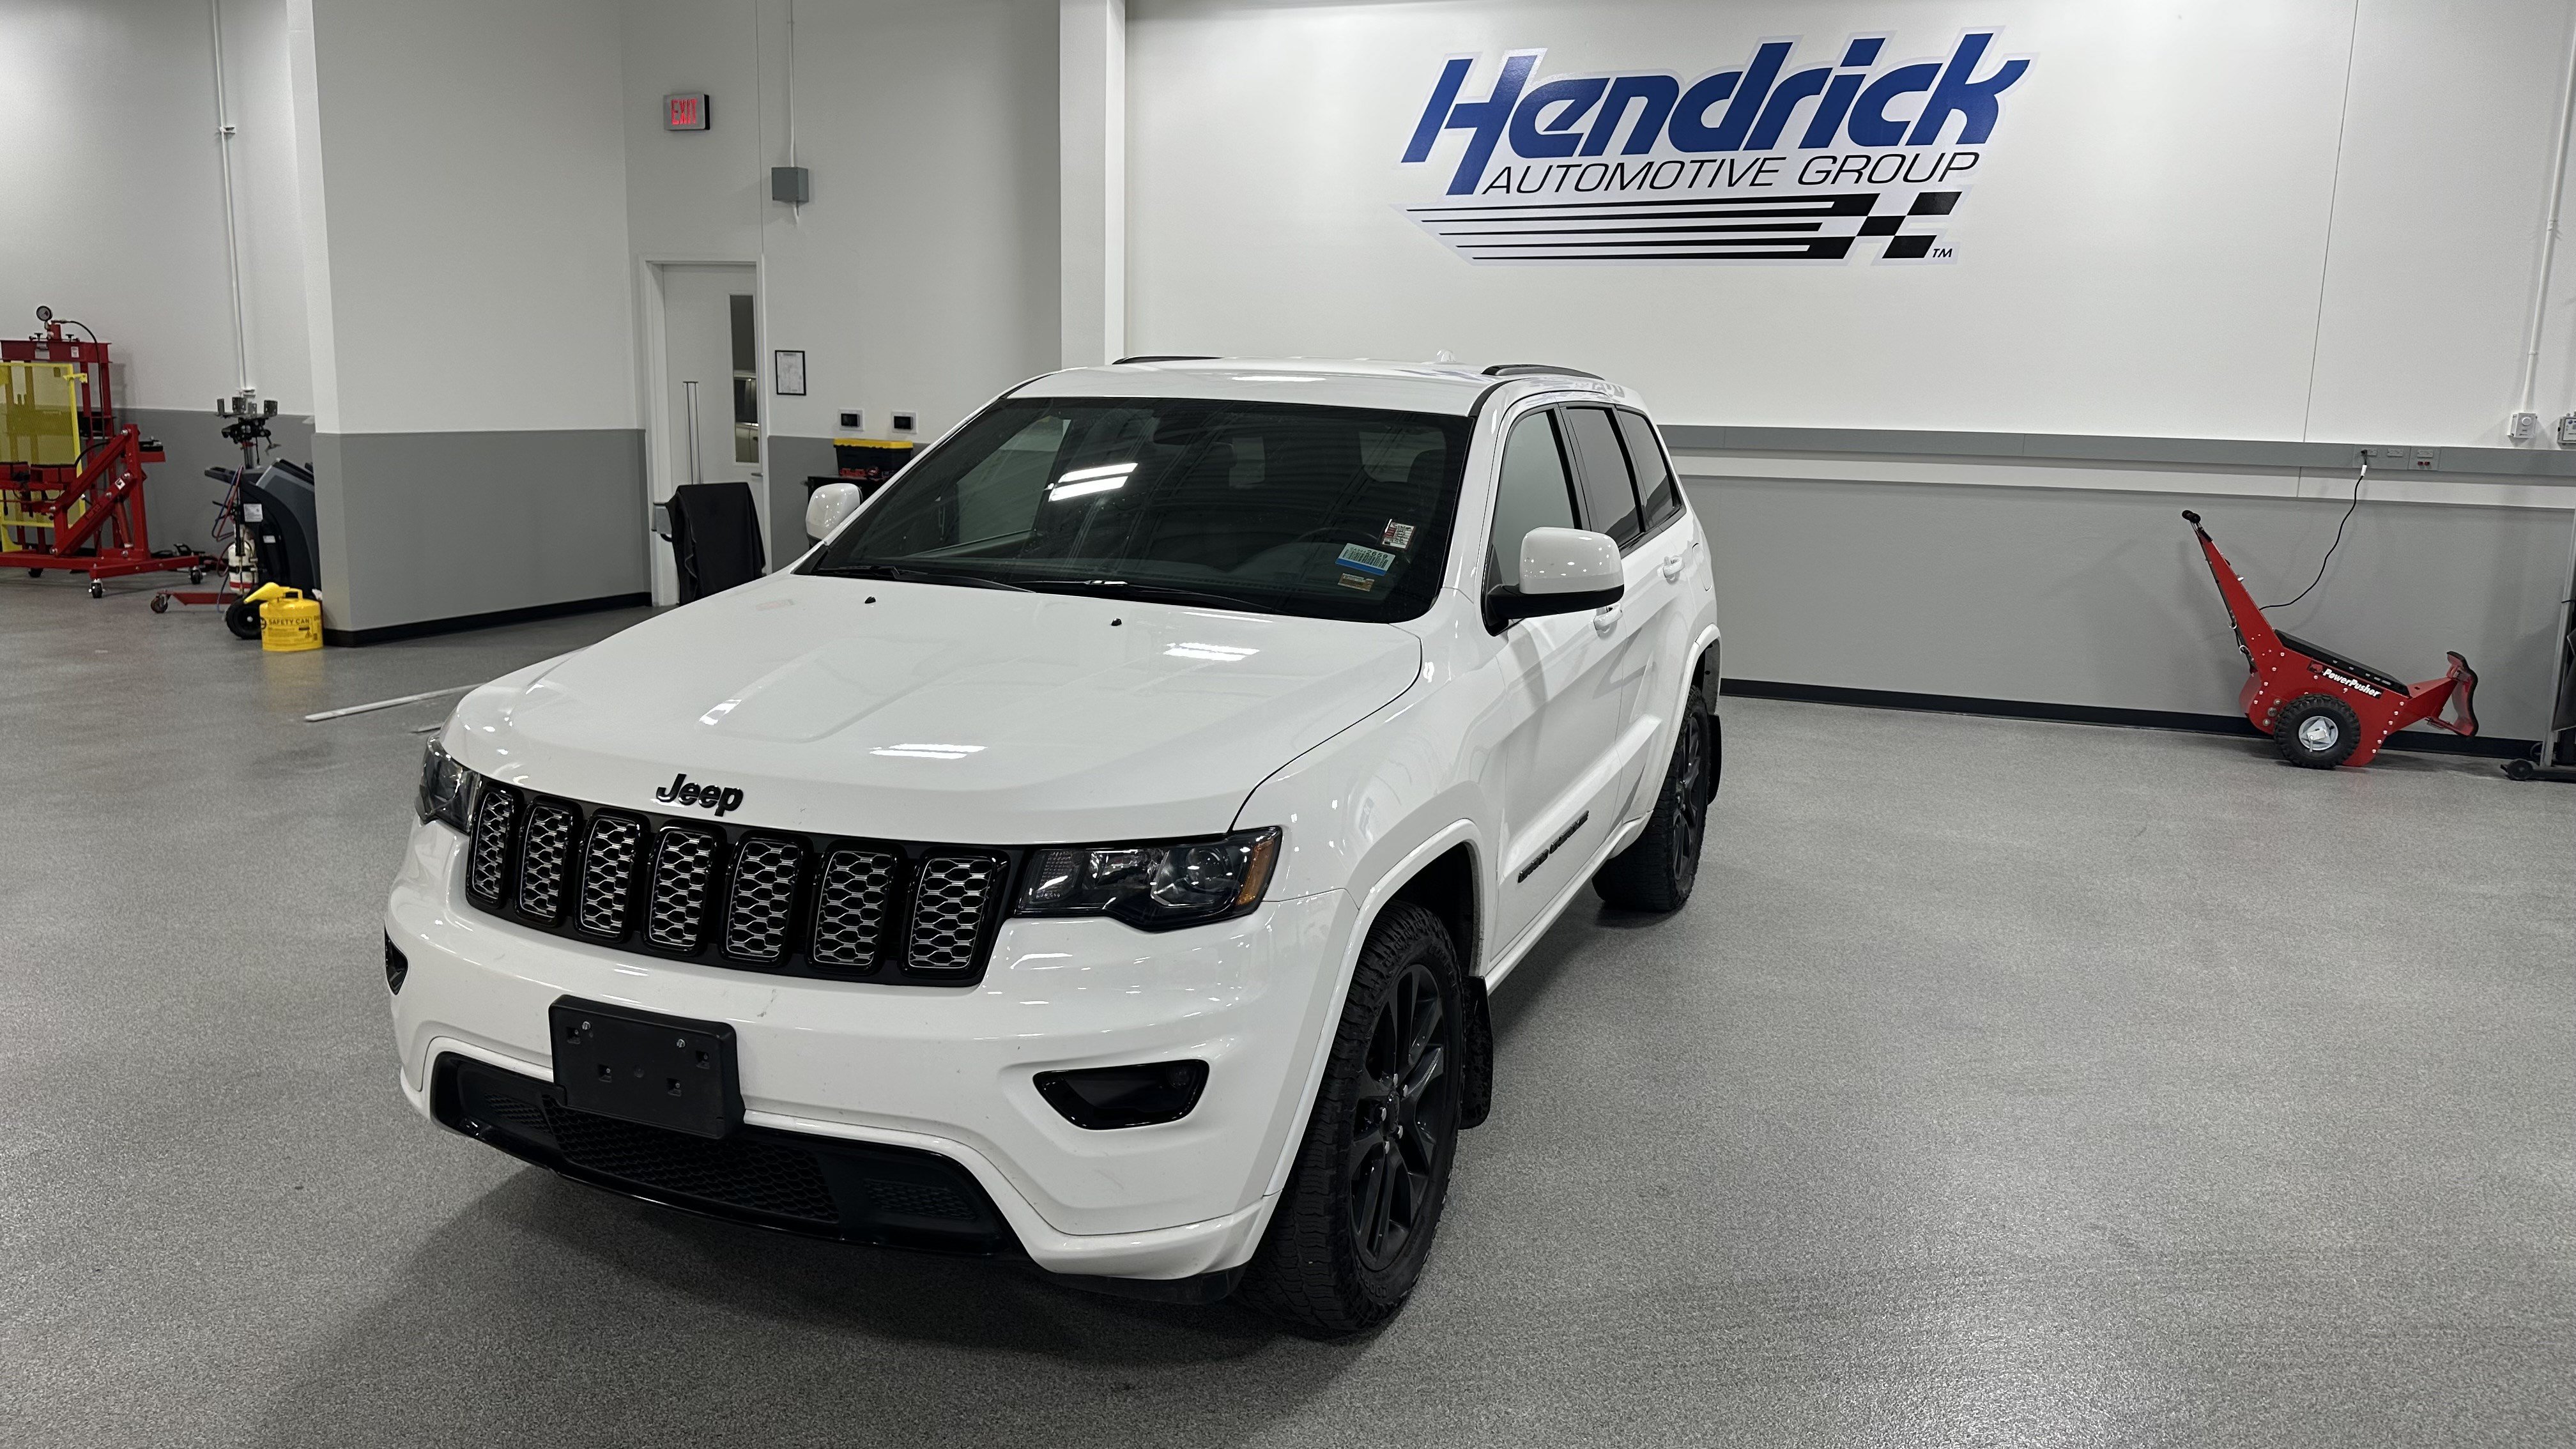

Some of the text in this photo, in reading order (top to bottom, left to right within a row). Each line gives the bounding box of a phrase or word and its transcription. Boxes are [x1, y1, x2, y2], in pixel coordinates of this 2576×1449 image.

[671, 98, 697, 125] EXIT
[1401, 33, 2030, 195] Hendrick
[1482, 151, 1980, 195] AUTOMOTIVE GROUP
[1932, 248, 1952, 258] TM
[2322, 668, 2380, 697] PowerPusher
[656, 773, 744, 817] Jeep
